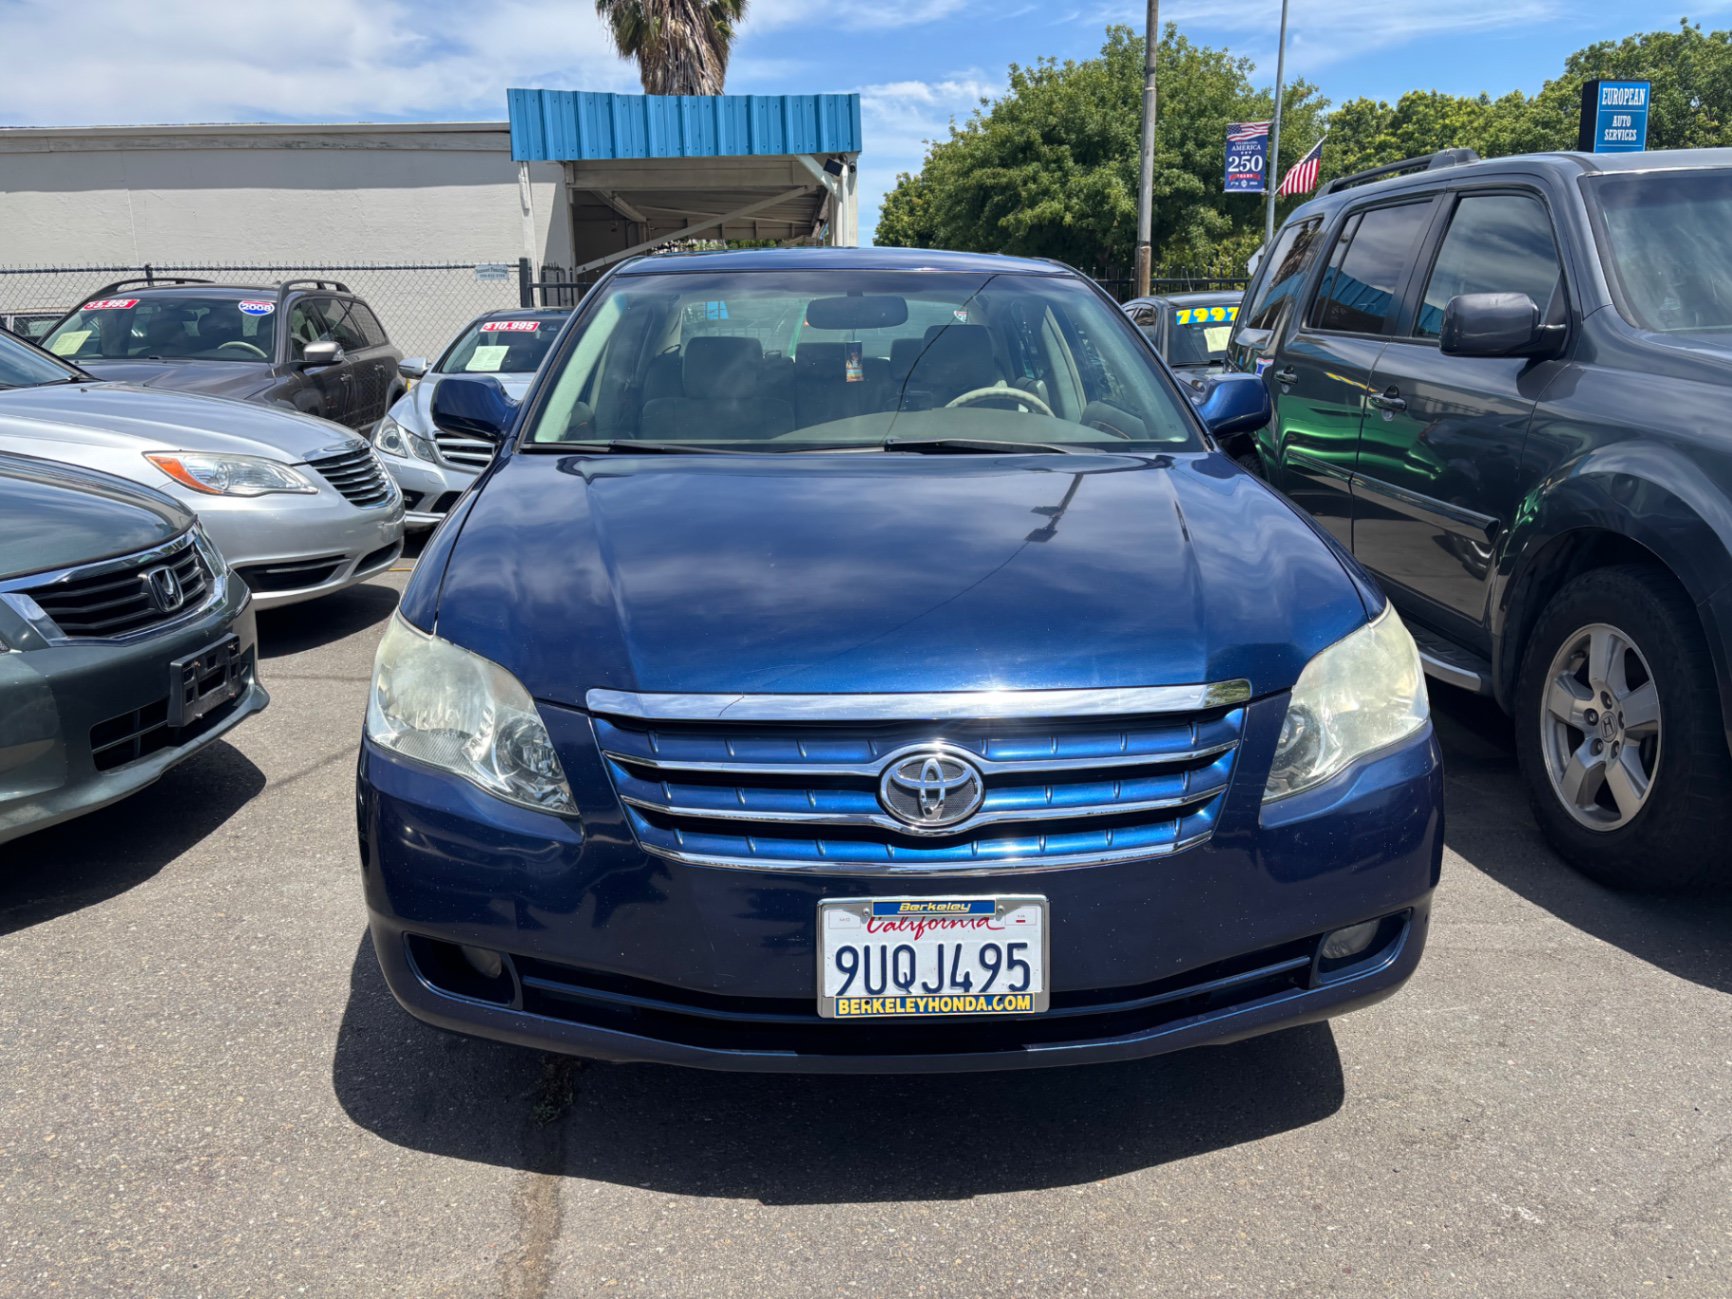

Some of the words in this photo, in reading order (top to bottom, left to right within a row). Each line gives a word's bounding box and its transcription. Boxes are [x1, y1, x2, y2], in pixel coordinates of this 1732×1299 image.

[1602, 87, 1646, 105] EUROPEAN
[1612, 115, 1632, 127] AUTO
[1604, 129, 1637, 141] SERVICES
[1228, 155, 1263, 172] 250
[240, 303, 273, 311] 2008
[899, 902, 972, 912] Berkeley
[866, 916, 1005, 941] California
[835, 942, 1031, 995] 9UQJ495
[838, 995, 1031, 1015] BERKELEYHONDA.COM
